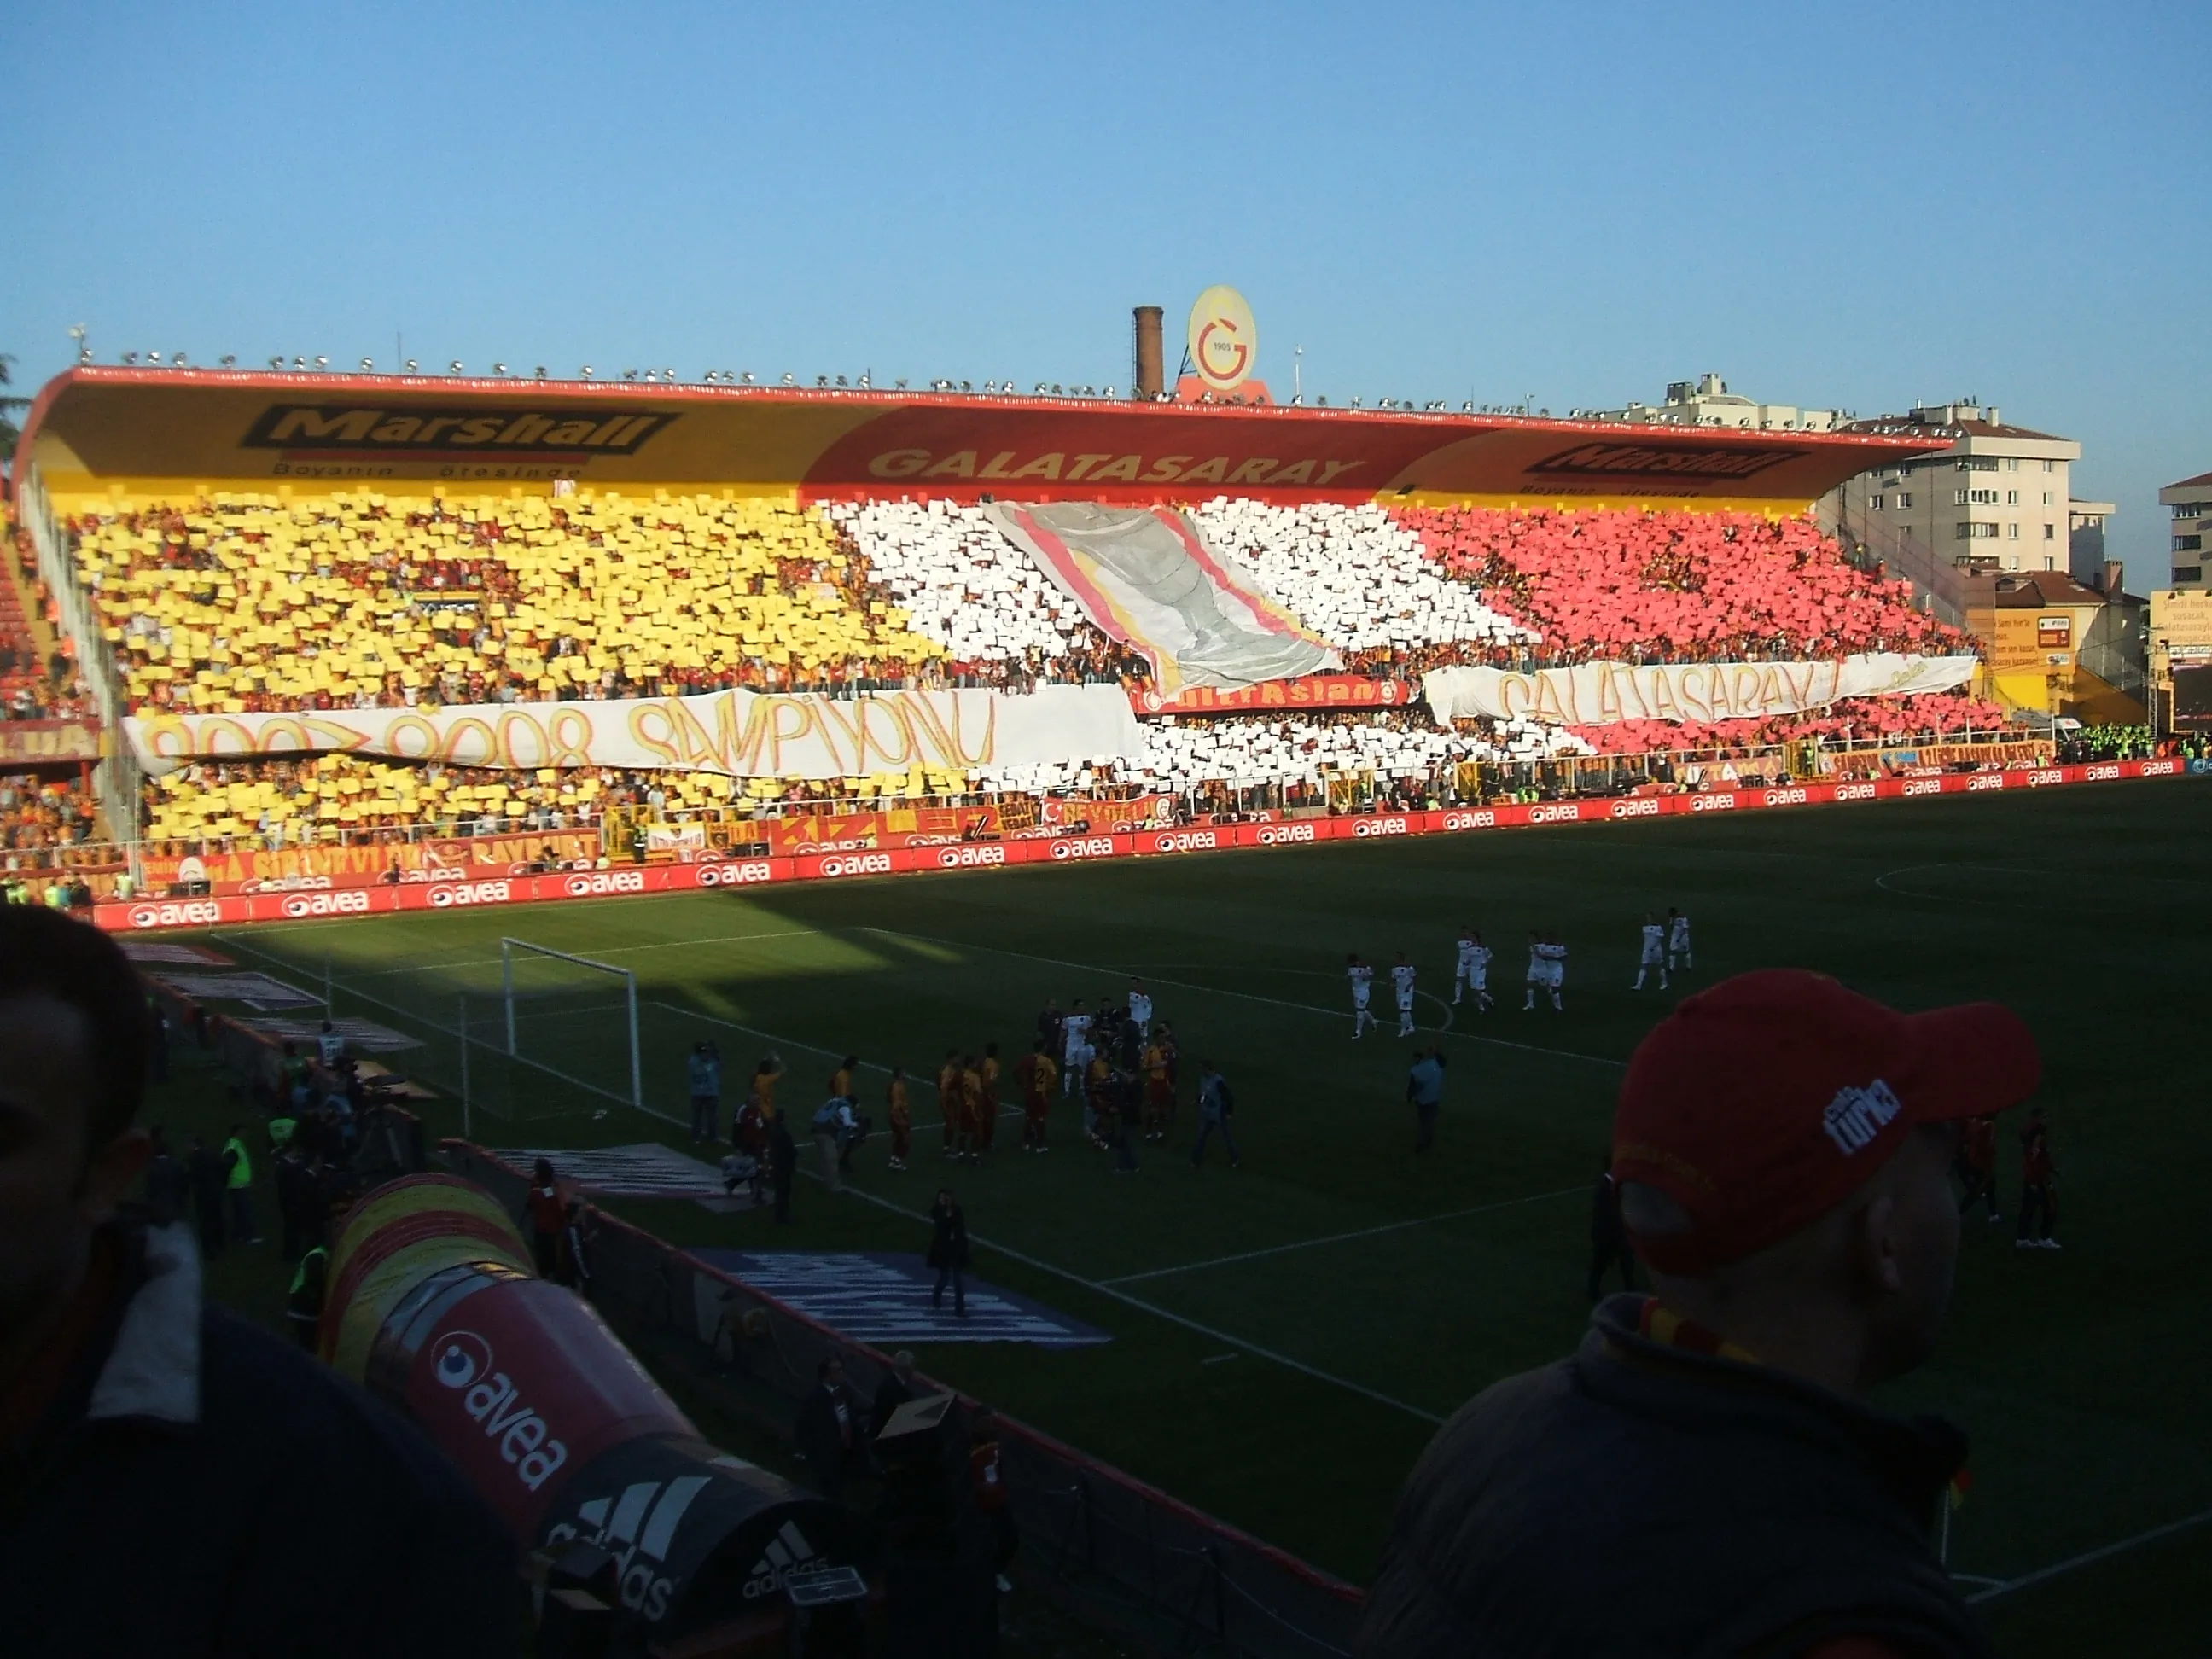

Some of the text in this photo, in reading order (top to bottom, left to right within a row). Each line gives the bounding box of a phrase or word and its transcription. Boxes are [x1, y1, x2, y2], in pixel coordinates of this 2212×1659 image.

[1214, 342, 1231, 351] 1905
[268, 408, 649, 447] Marshall
[868, 449, 1366, 485] GALATASARAY
[1541, 445, 1796, 474] Marshall
[1977, 774, 2003, 789] avea
[2039, 770, 2062, 784] avea
[1848, 784, 1875, 799] avea
[1915, 779, 1941, 794] avea
[1705, 795, 1734, 811] avea
[1778, 789, 1806, 804] avea
[1545, 804, 1578, 822] avea
[1627, 799, 1658, 816] avea
[1371, 817, 1406, 835] avea
[1460, 811, 1494, 829] avea
[1176, 831, 1216, 850] avea
[1276, 824, 1314, 842] avea
[961, 845, 1005, 865] avea
[1071, 837, 1113, 857] avea
[722, 861, 771, 883] avea
[844, 853, 890, 875] avea
[454, 877, 509, 905] avea
[591, 871, 643, 893] avea
[311, 891, 369, 914] avea
[160, 900, 221, 925] avea
[1036, 1068, 1045, 1084] 2
[465, 1375, 568, 1492] avea
